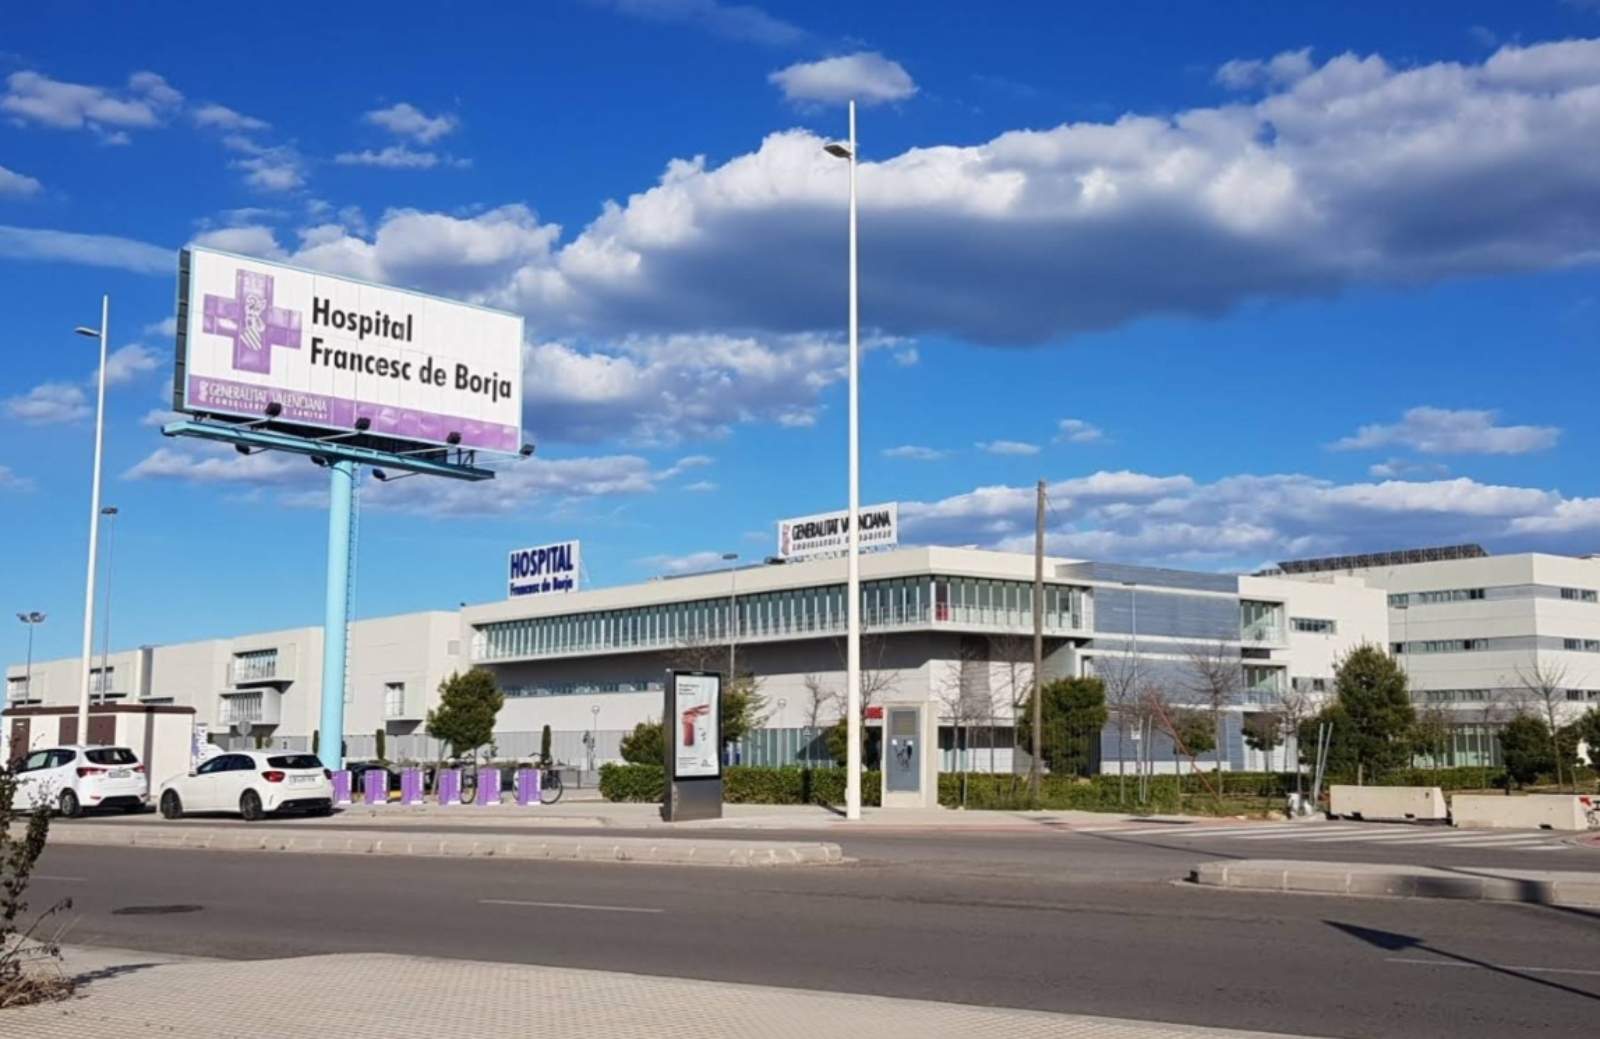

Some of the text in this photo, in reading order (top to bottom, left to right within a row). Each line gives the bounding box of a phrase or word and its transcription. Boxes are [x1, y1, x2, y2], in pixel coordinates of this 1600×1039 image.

[312, 297, 412, 342] Hospital
[310, 337, 512, 403] Francesc de Borja
[208, 383, 328, 412] GENERALITAT VALENCIANA
[792, 518, 839, 541] GENERALITAT
[510, 544, 574, 579] HOSPITAL
